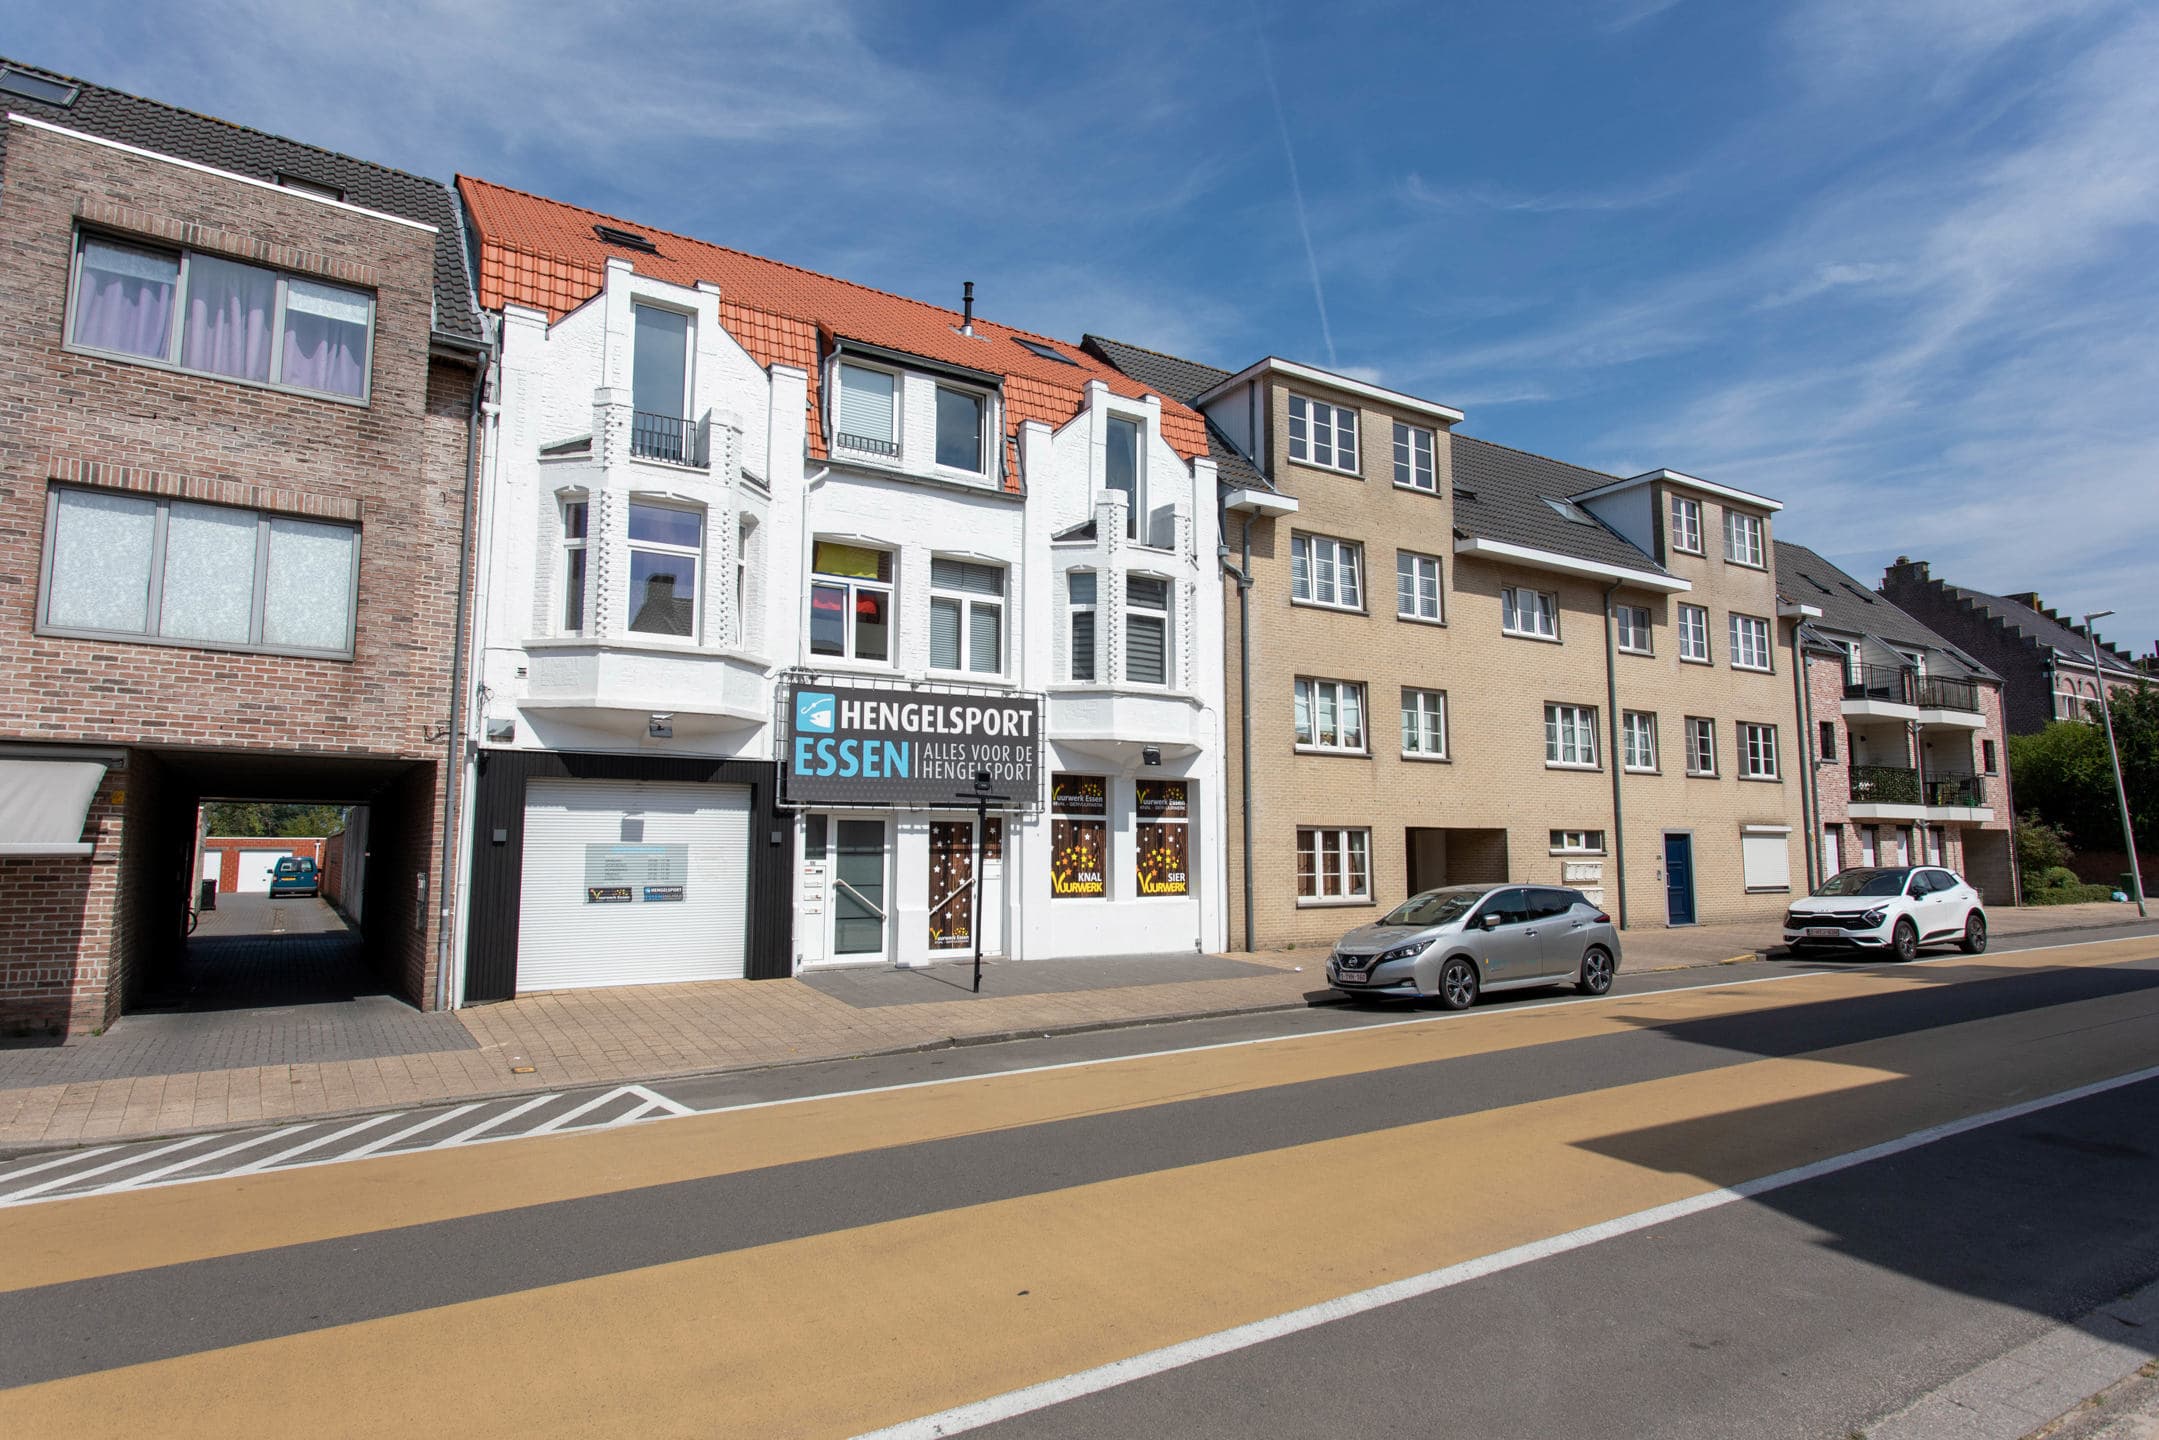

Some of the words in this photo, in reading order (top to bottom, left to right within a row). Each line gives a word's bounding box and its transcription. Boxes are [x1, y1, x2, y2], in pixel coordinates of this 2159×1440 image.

[841, 700, 1033, 737] HENGELSPORT
[795, 736, 909, 779] ESSEN
[923, 742, 966, 761] ALLES
[971, 744, 1010, 762] VOOR
[1016, 746, 1033, 762] DE
[1085, 795, 1103, 803] Essen
[1078, 872, 1102, 882] KNAL
[1168, 872, 1186, 882] SIER
